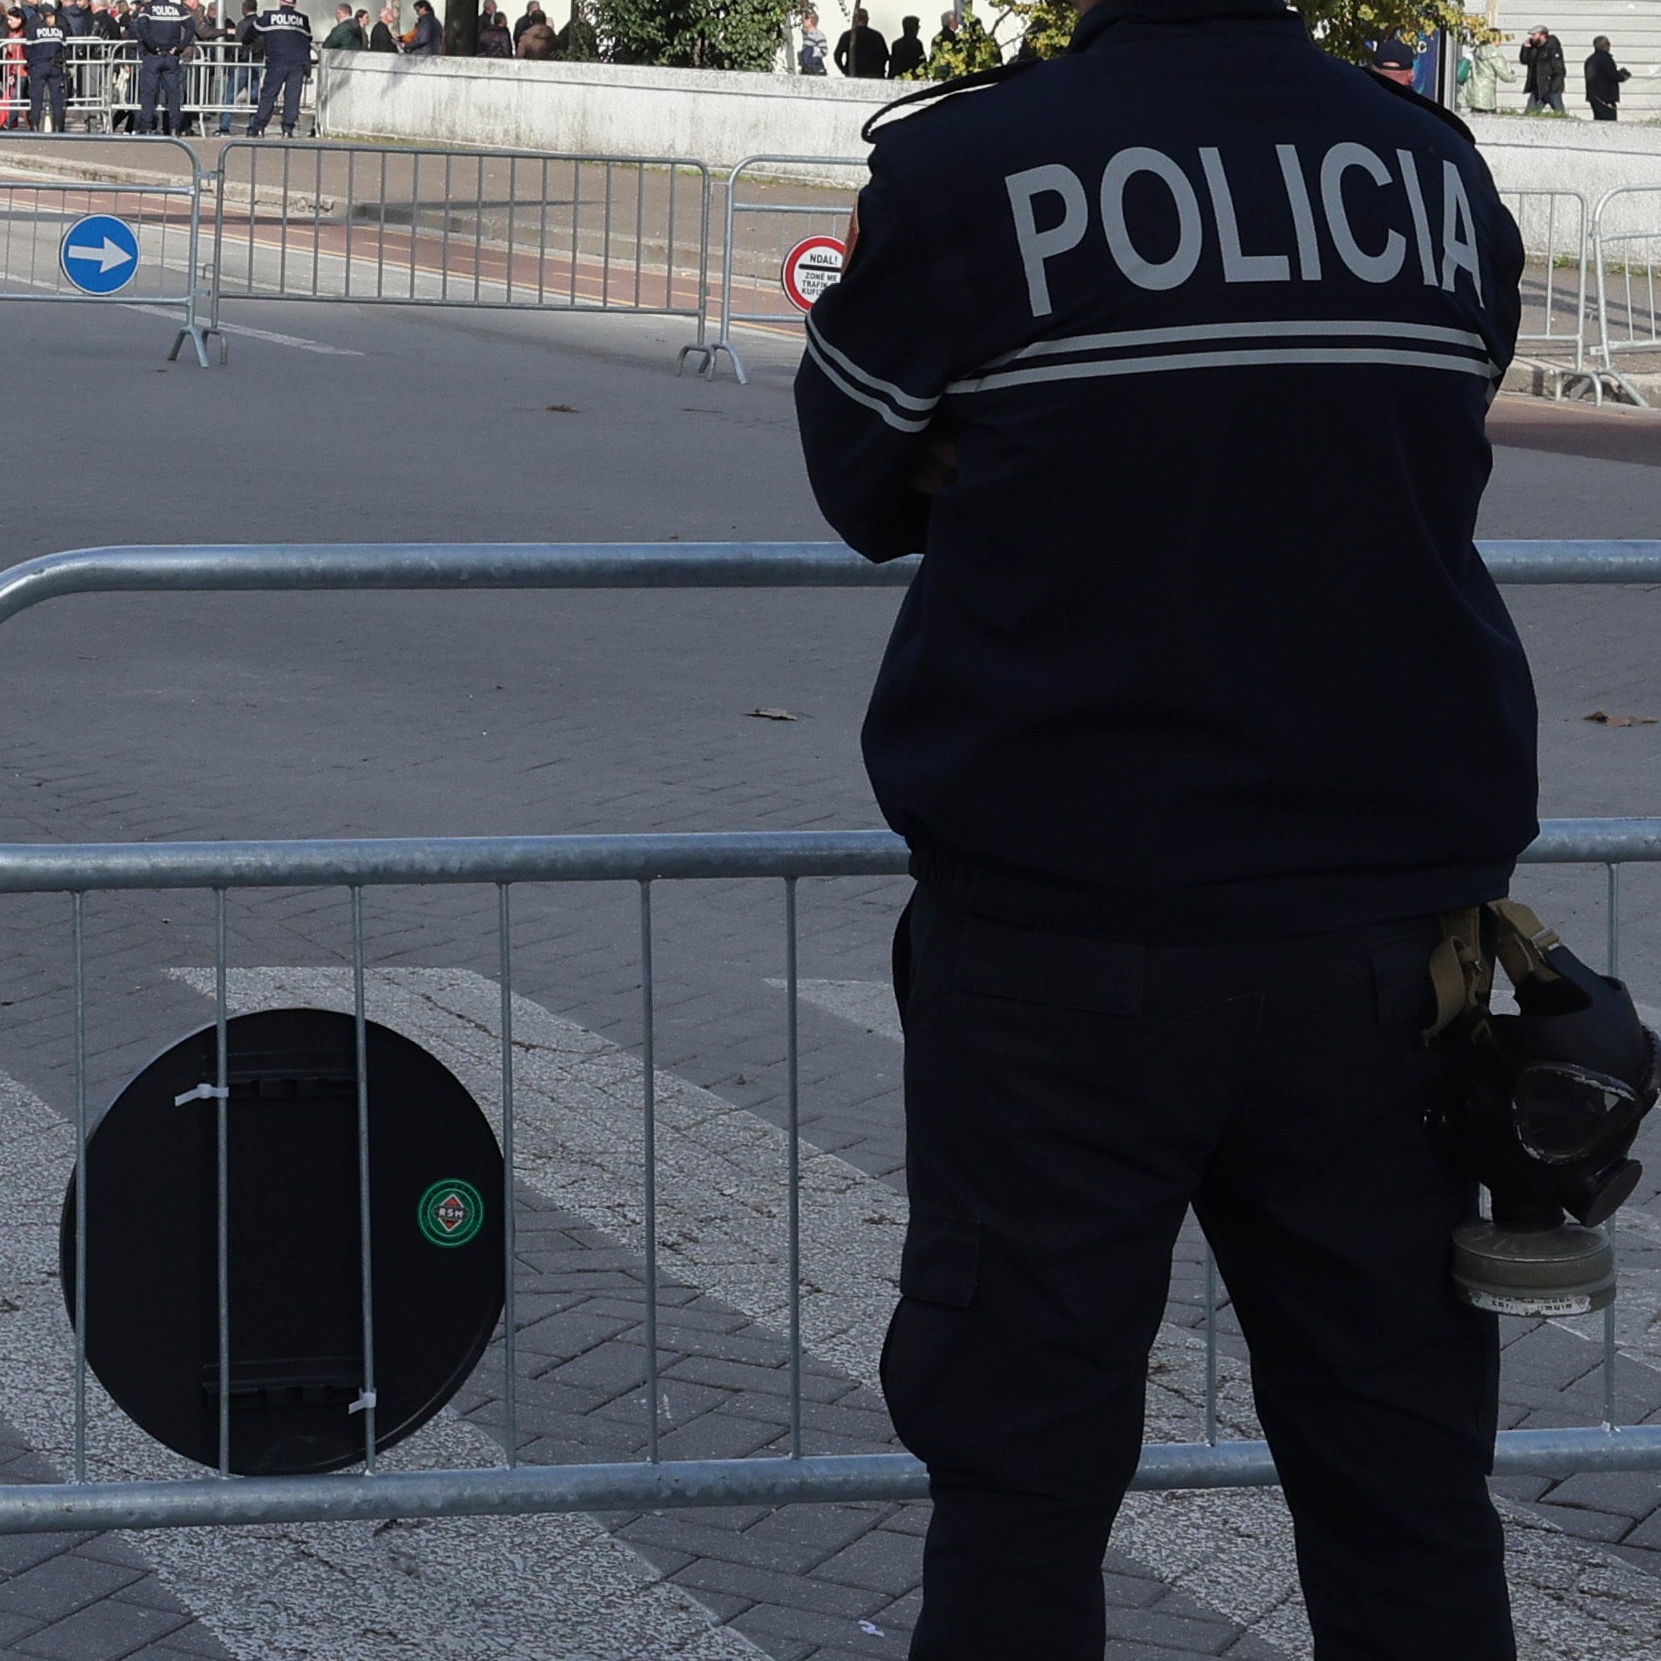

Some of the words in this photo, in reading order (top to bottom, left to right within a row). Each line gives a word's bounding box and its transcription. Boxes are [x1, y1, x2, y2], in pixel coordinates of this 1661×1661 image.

[152, 5, 180, 17] POLICIA
[271, 14, 304, 27] POLICIA
[1004, 142, 1485, 317] POLICIA
[809, 253, 838, 265] NDAL!
[805, 272, 825, 280] ZONË
[802, 280, 828, 288] TRAFIK
[801, 288, 823, 296] KUFI
[438, 1207, 465, 1218] RSM
